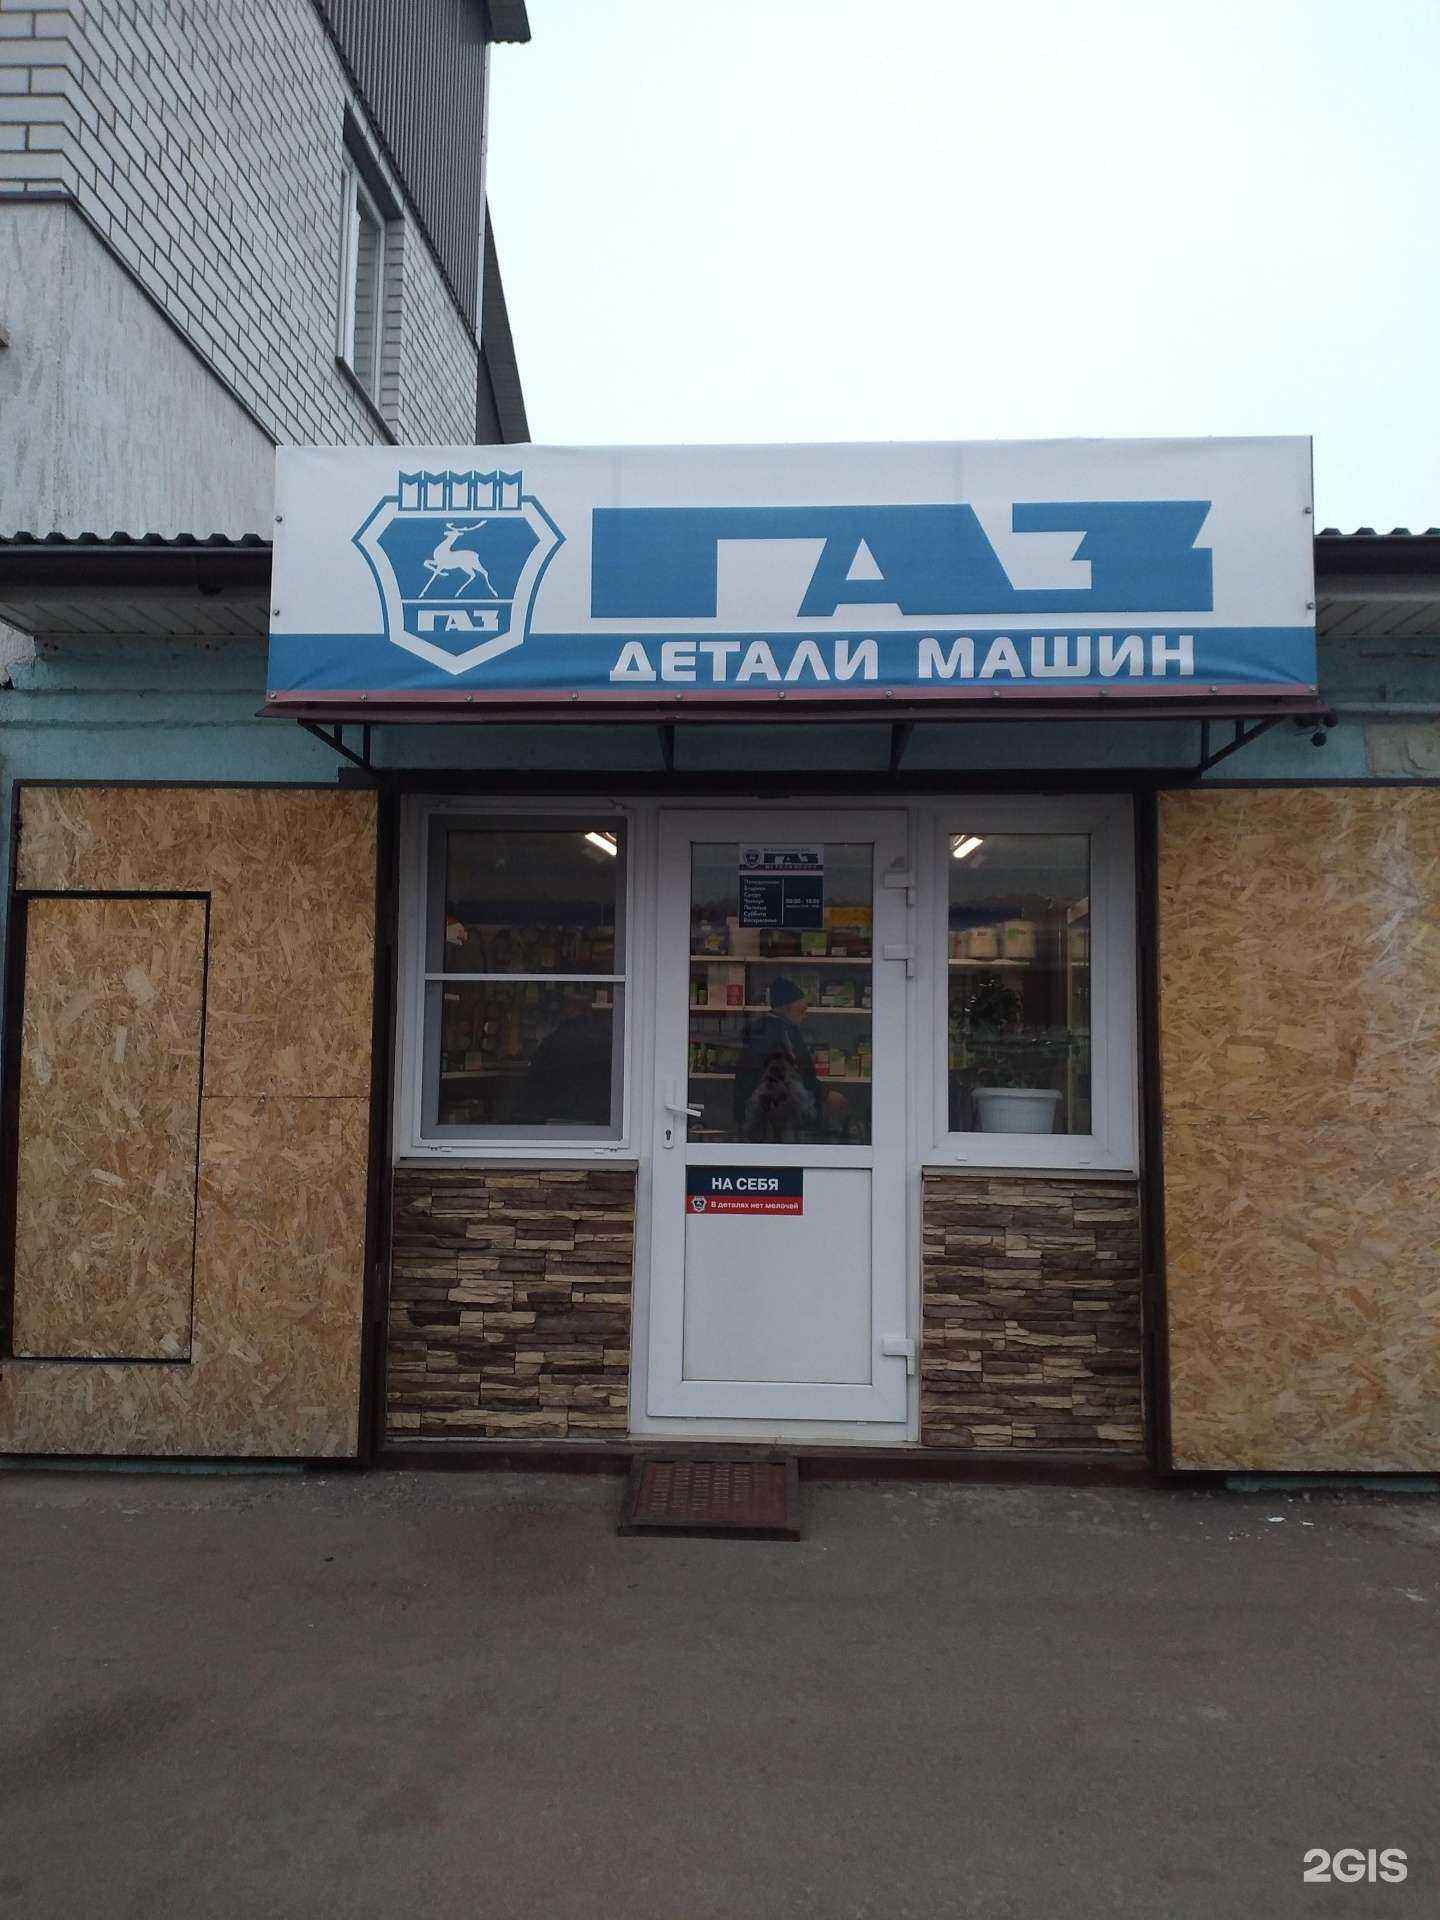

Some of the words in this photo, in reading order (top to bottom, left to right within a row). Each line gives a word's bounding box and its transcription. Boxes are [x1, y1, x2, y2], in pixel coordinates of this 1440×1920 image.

[591, 501, 1214, 617] ГАЗ
[417, 609, 499, 632] ГАЗ
[609, 637, 880, 683] ДЕТАЛИ
[916, 633, 1195, 679] МАШИН
[711, 1177, 733, 1190] НА
[736, 1177, 779, 1191] СЕБЯ
